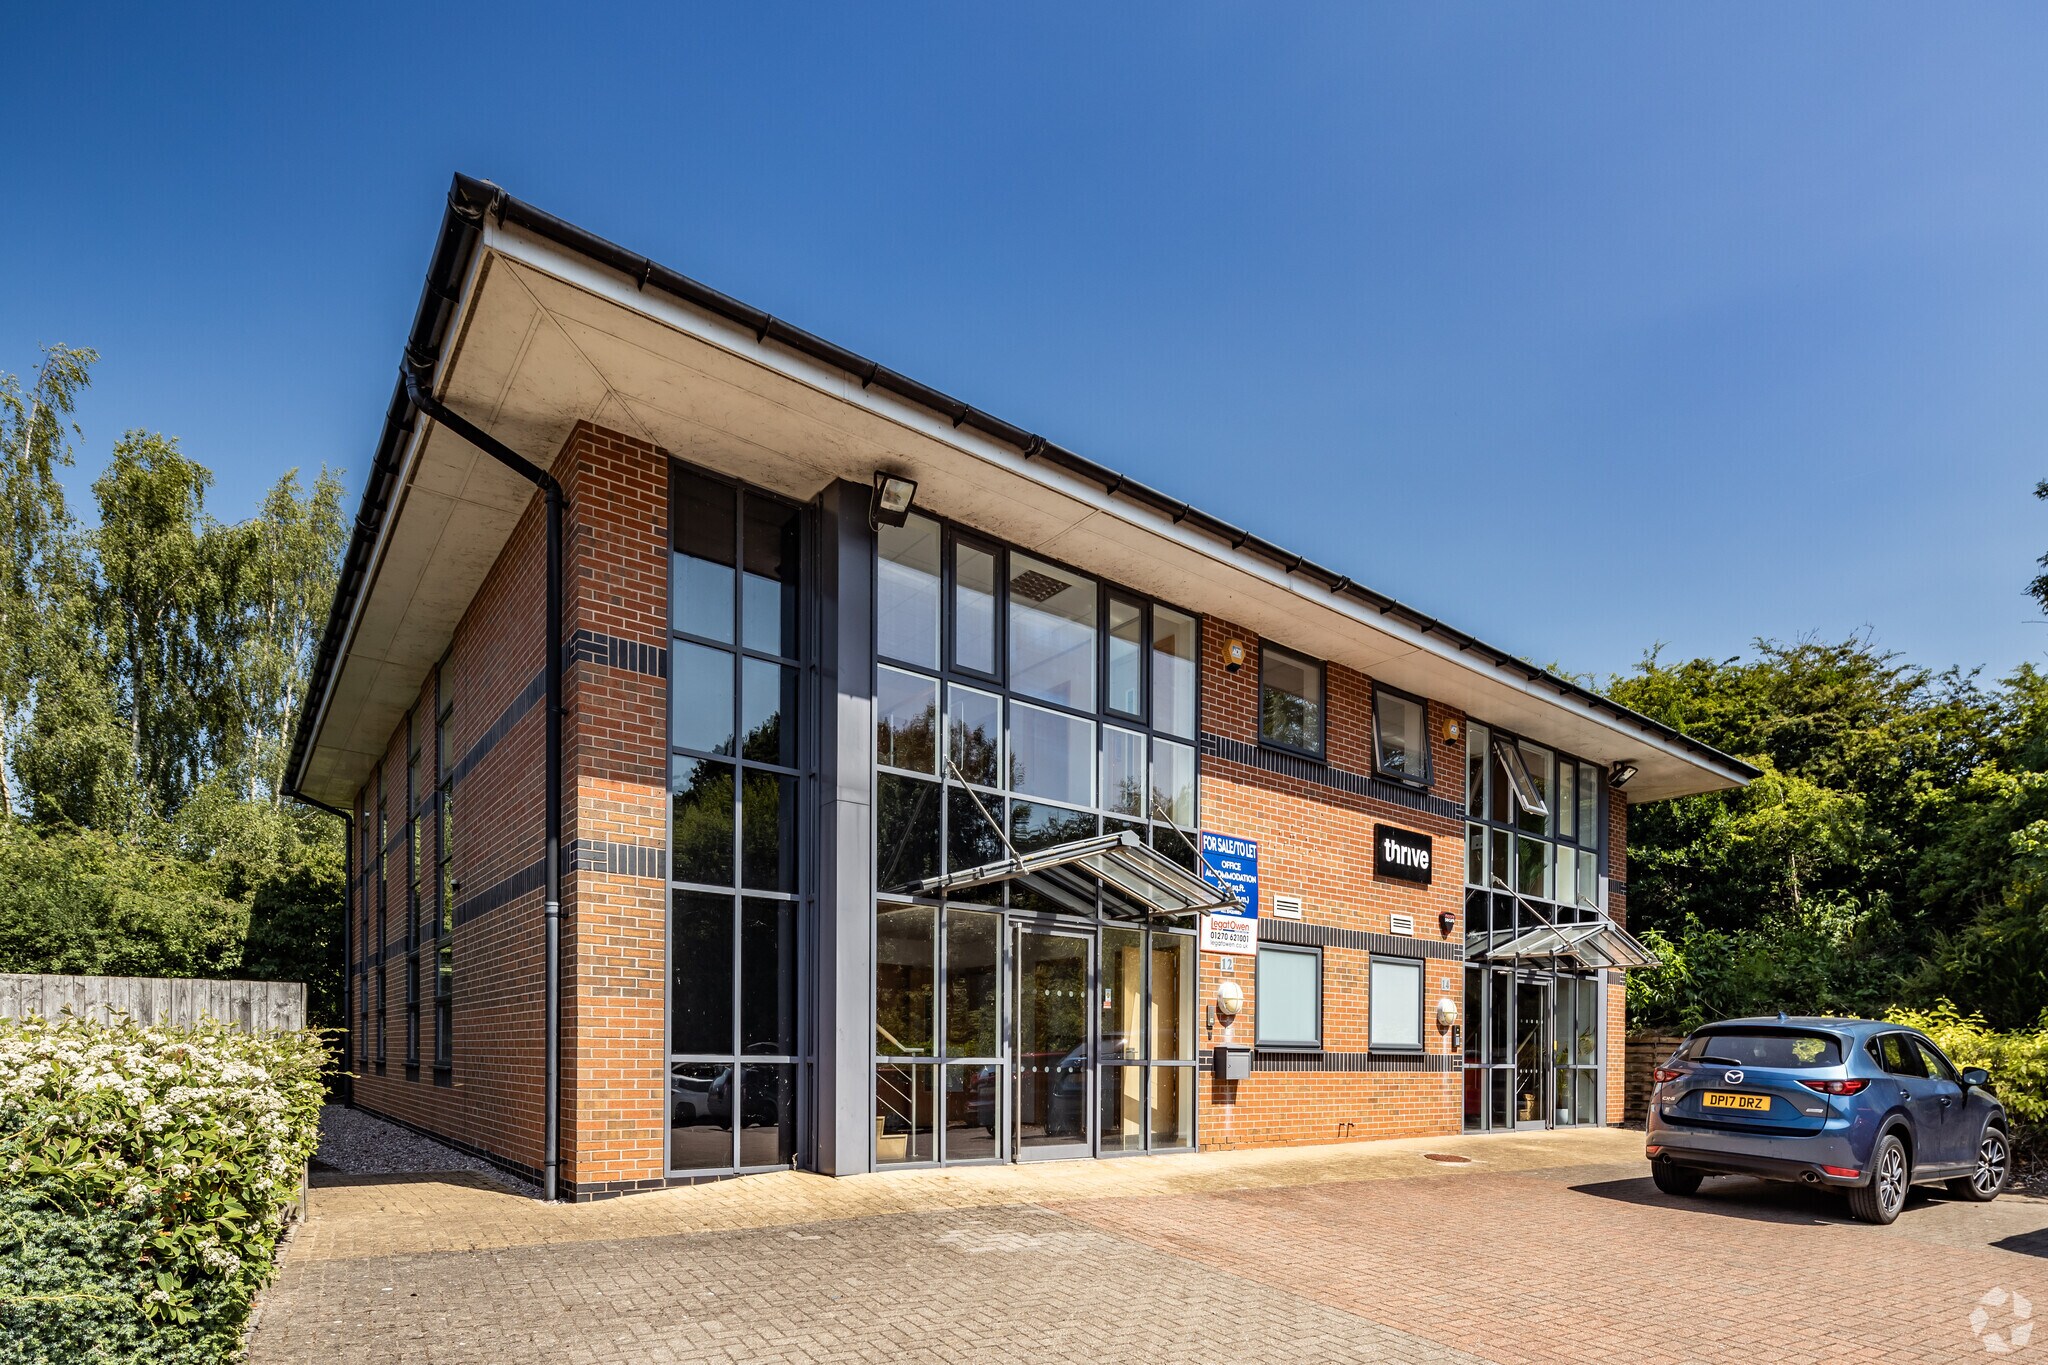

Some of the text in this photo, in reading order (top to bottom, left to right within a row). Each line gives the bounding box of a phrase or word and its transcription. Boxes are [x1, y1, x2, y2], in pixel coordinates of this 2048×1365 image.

[1203, 835, 1257, 859] FOR SALE/TO LET
[1384, 838, 1429, 870] thrive
[1221, 860, 1242, 871] OFFICE
[1205, 868, 1257, 884] ACOMMODATION
[1210, 917, 1250, 931] LegatOwen
[1210, 931, 1229, 941] 01270
[1222, 958, 1233, 971] 12
[1710, 1095, 1763, 1109] DP17 DRZ
